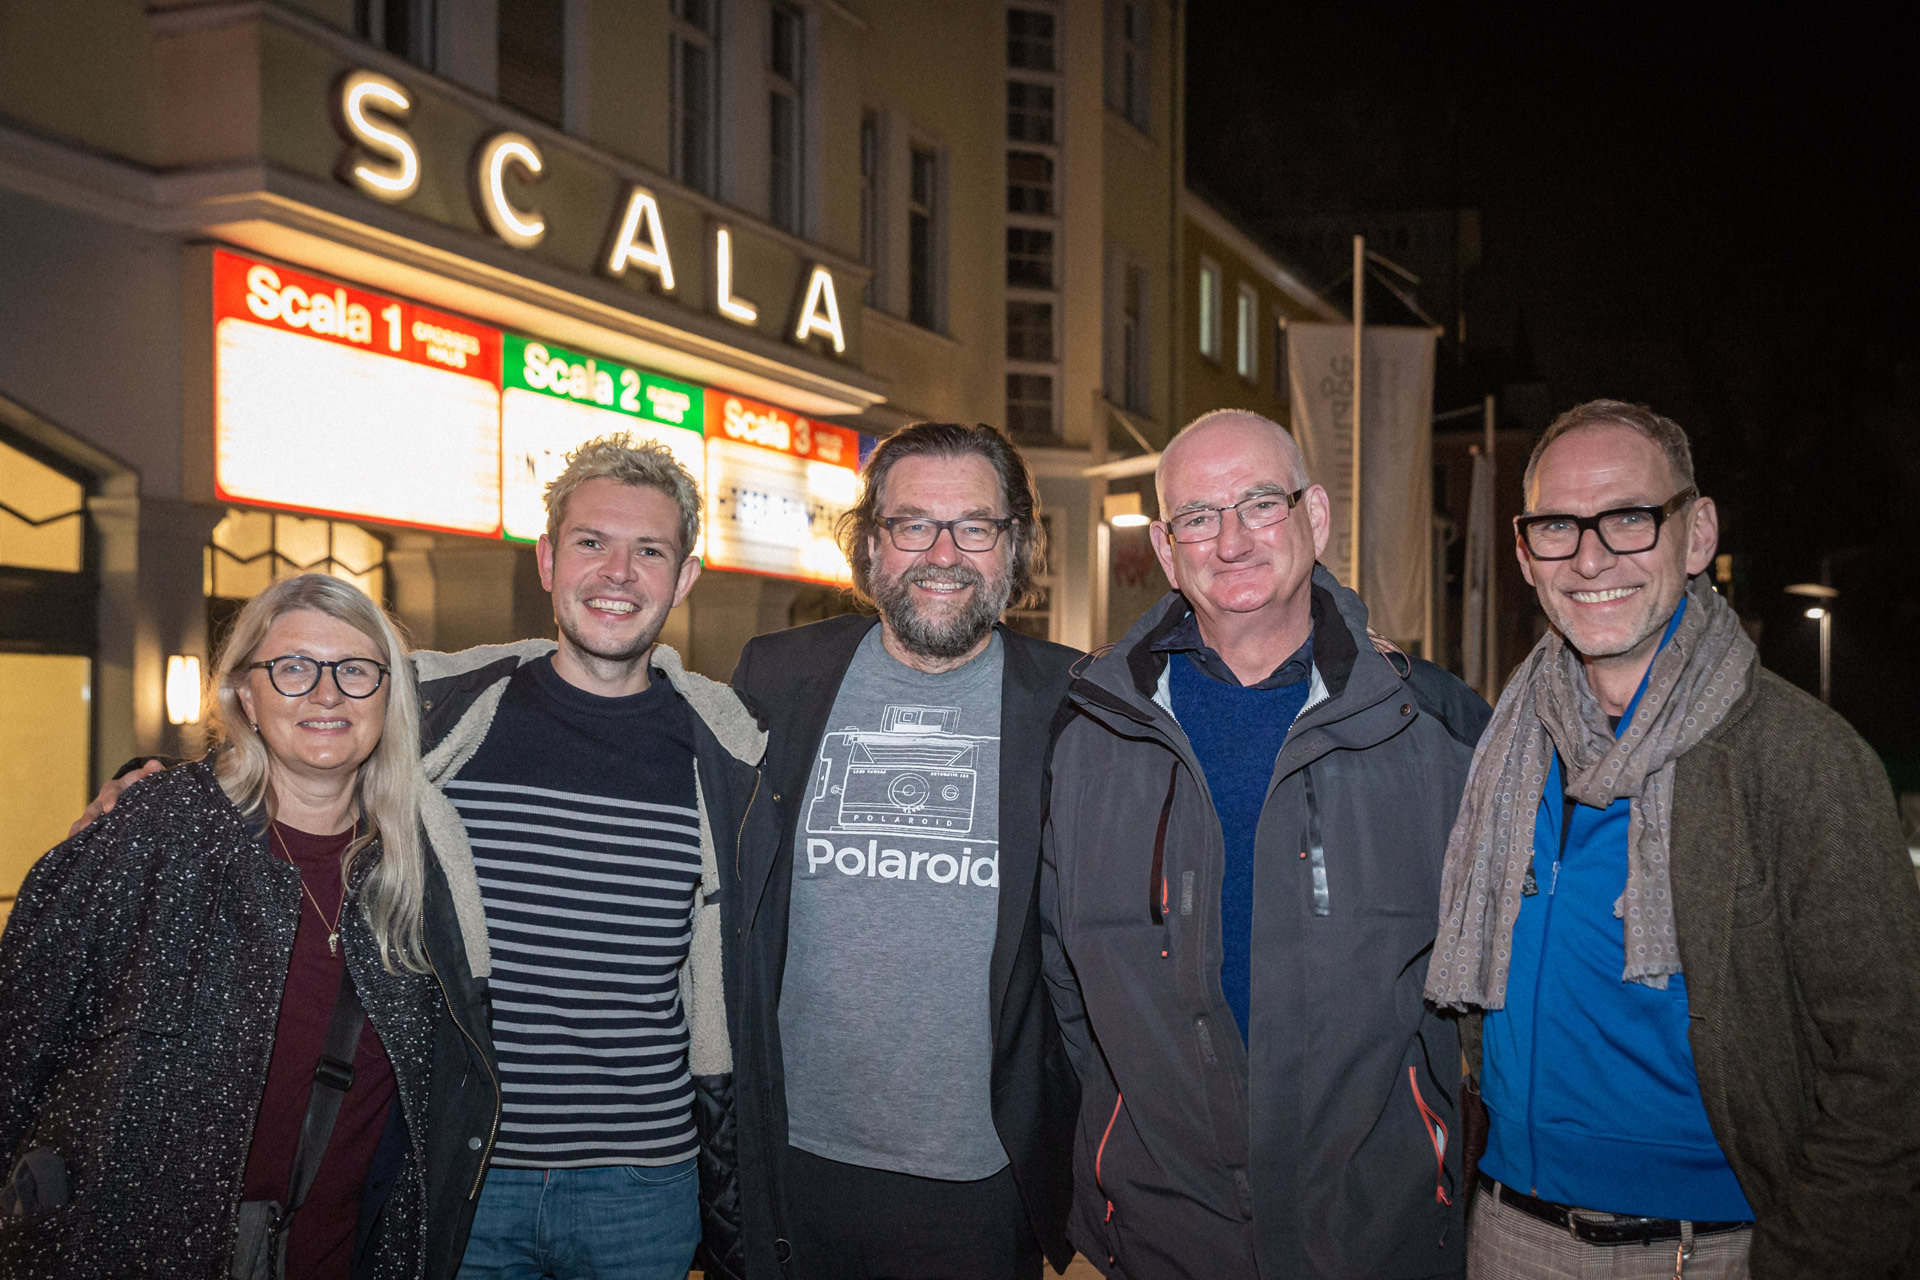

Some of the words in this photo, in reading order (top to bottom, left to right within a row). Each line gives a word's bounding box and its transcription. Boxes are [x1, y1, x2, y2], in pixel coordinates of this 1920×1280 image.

[342, 70, 846, 354] SCALA
[246, 265, 372, 344] Scala
[381, 303, 402, 352] 1
[523, 342, 614, 406] Scala
[619, 369, 641, 413] 2
[723, 397, 791, 451] Scala
[794, 417, 811, 456] 3
[853, 814, 952, 827] POLAROID
[807, 838, 999, 888] Polaroid
